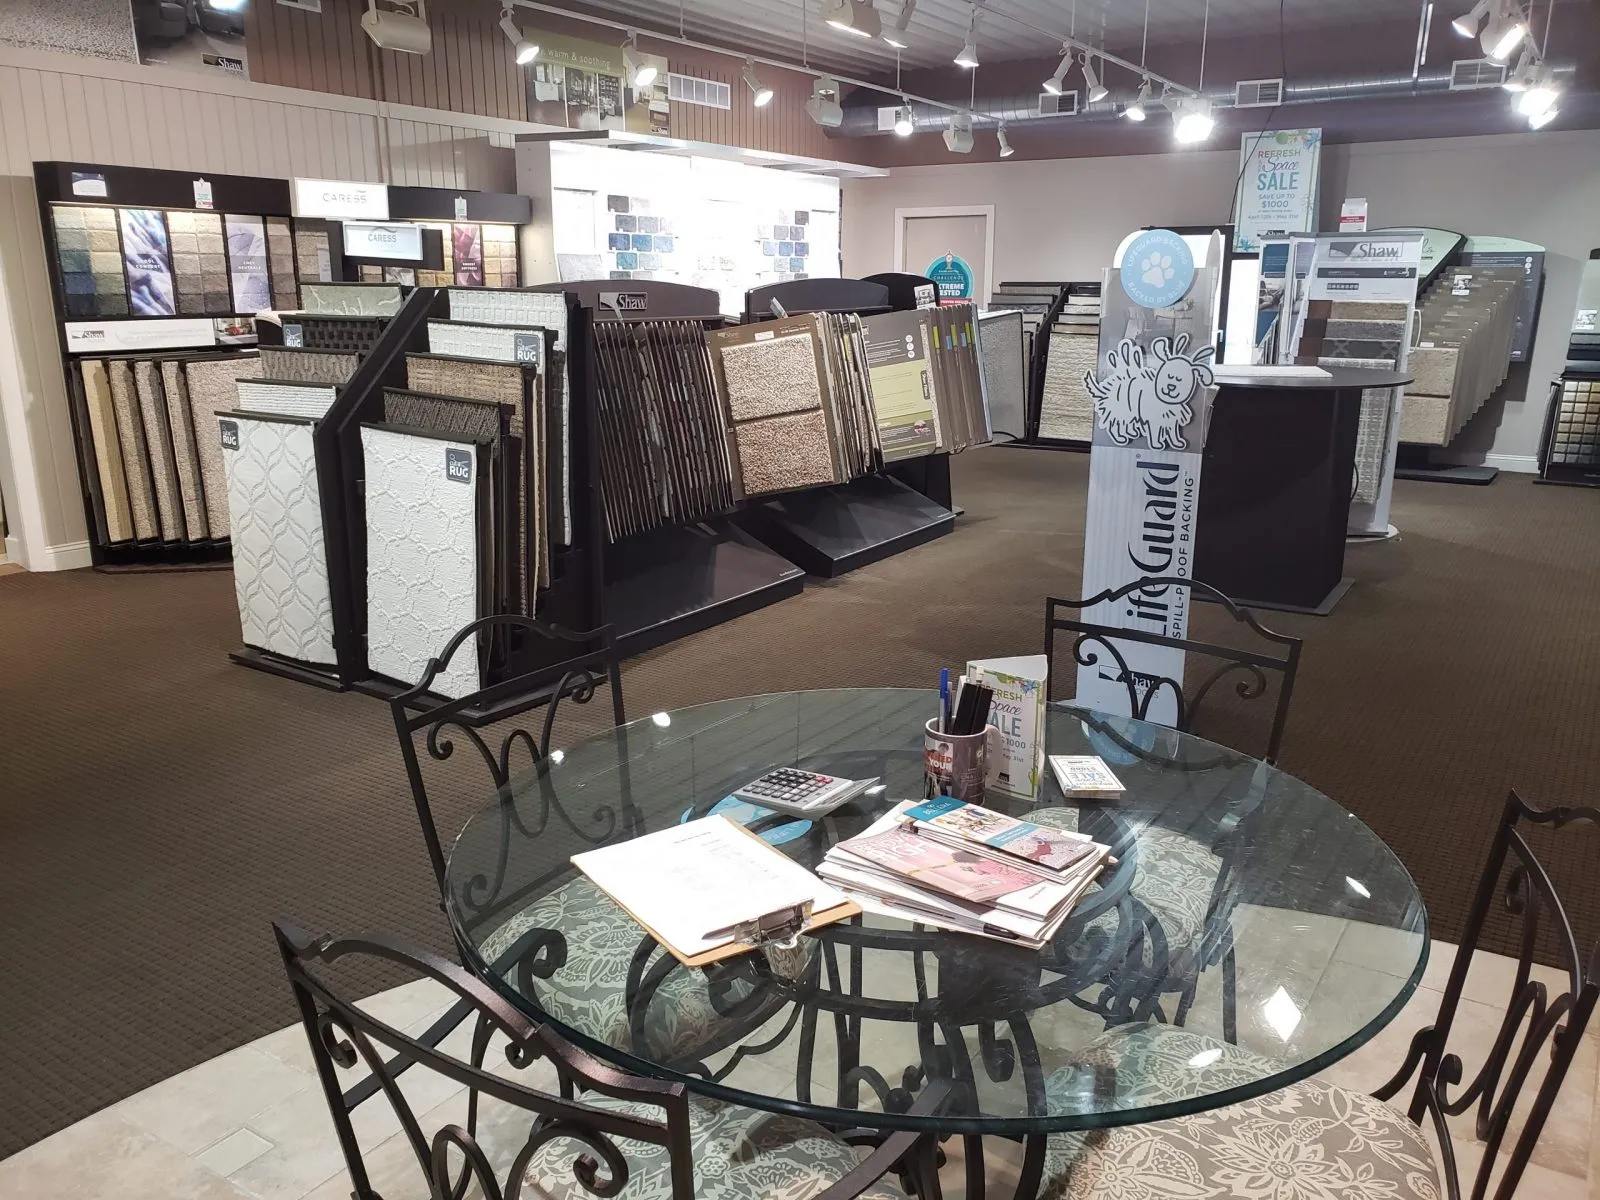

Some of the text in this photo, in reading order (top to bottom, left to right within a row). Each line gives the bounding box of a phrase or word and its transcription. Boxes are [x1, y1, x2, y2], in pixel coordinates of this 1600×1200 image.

[218, 57, 242, 71] Shaw
[548, 51, 569, 59] warm
[571, 52, 577, 61] &
[580, 56, 611, 71] soothing
[1257, 149, 1301, 159] REFRESH
[1262, 156, 1300, 173] Space
[1257, 171, 1300, 191] SALE
[322, 192, 368, 204] CARESS
[1261, 200, 1289, 209] $1000
[367, 233, 398, 243] CARESS
[1359, 243, 1399, 258] Shaw
[618, 294, 647, 309] Shaw
[286, 339, 301, 347] RUG
[517, 350, 537, 361] RUG
[222, 435, 237, 445] RUG
[449, 465, 469, 478] RUG
[1172, 476, 1195, 639] SPILL-POOF BACKING
[989, 711, 1022, 738] ALE
